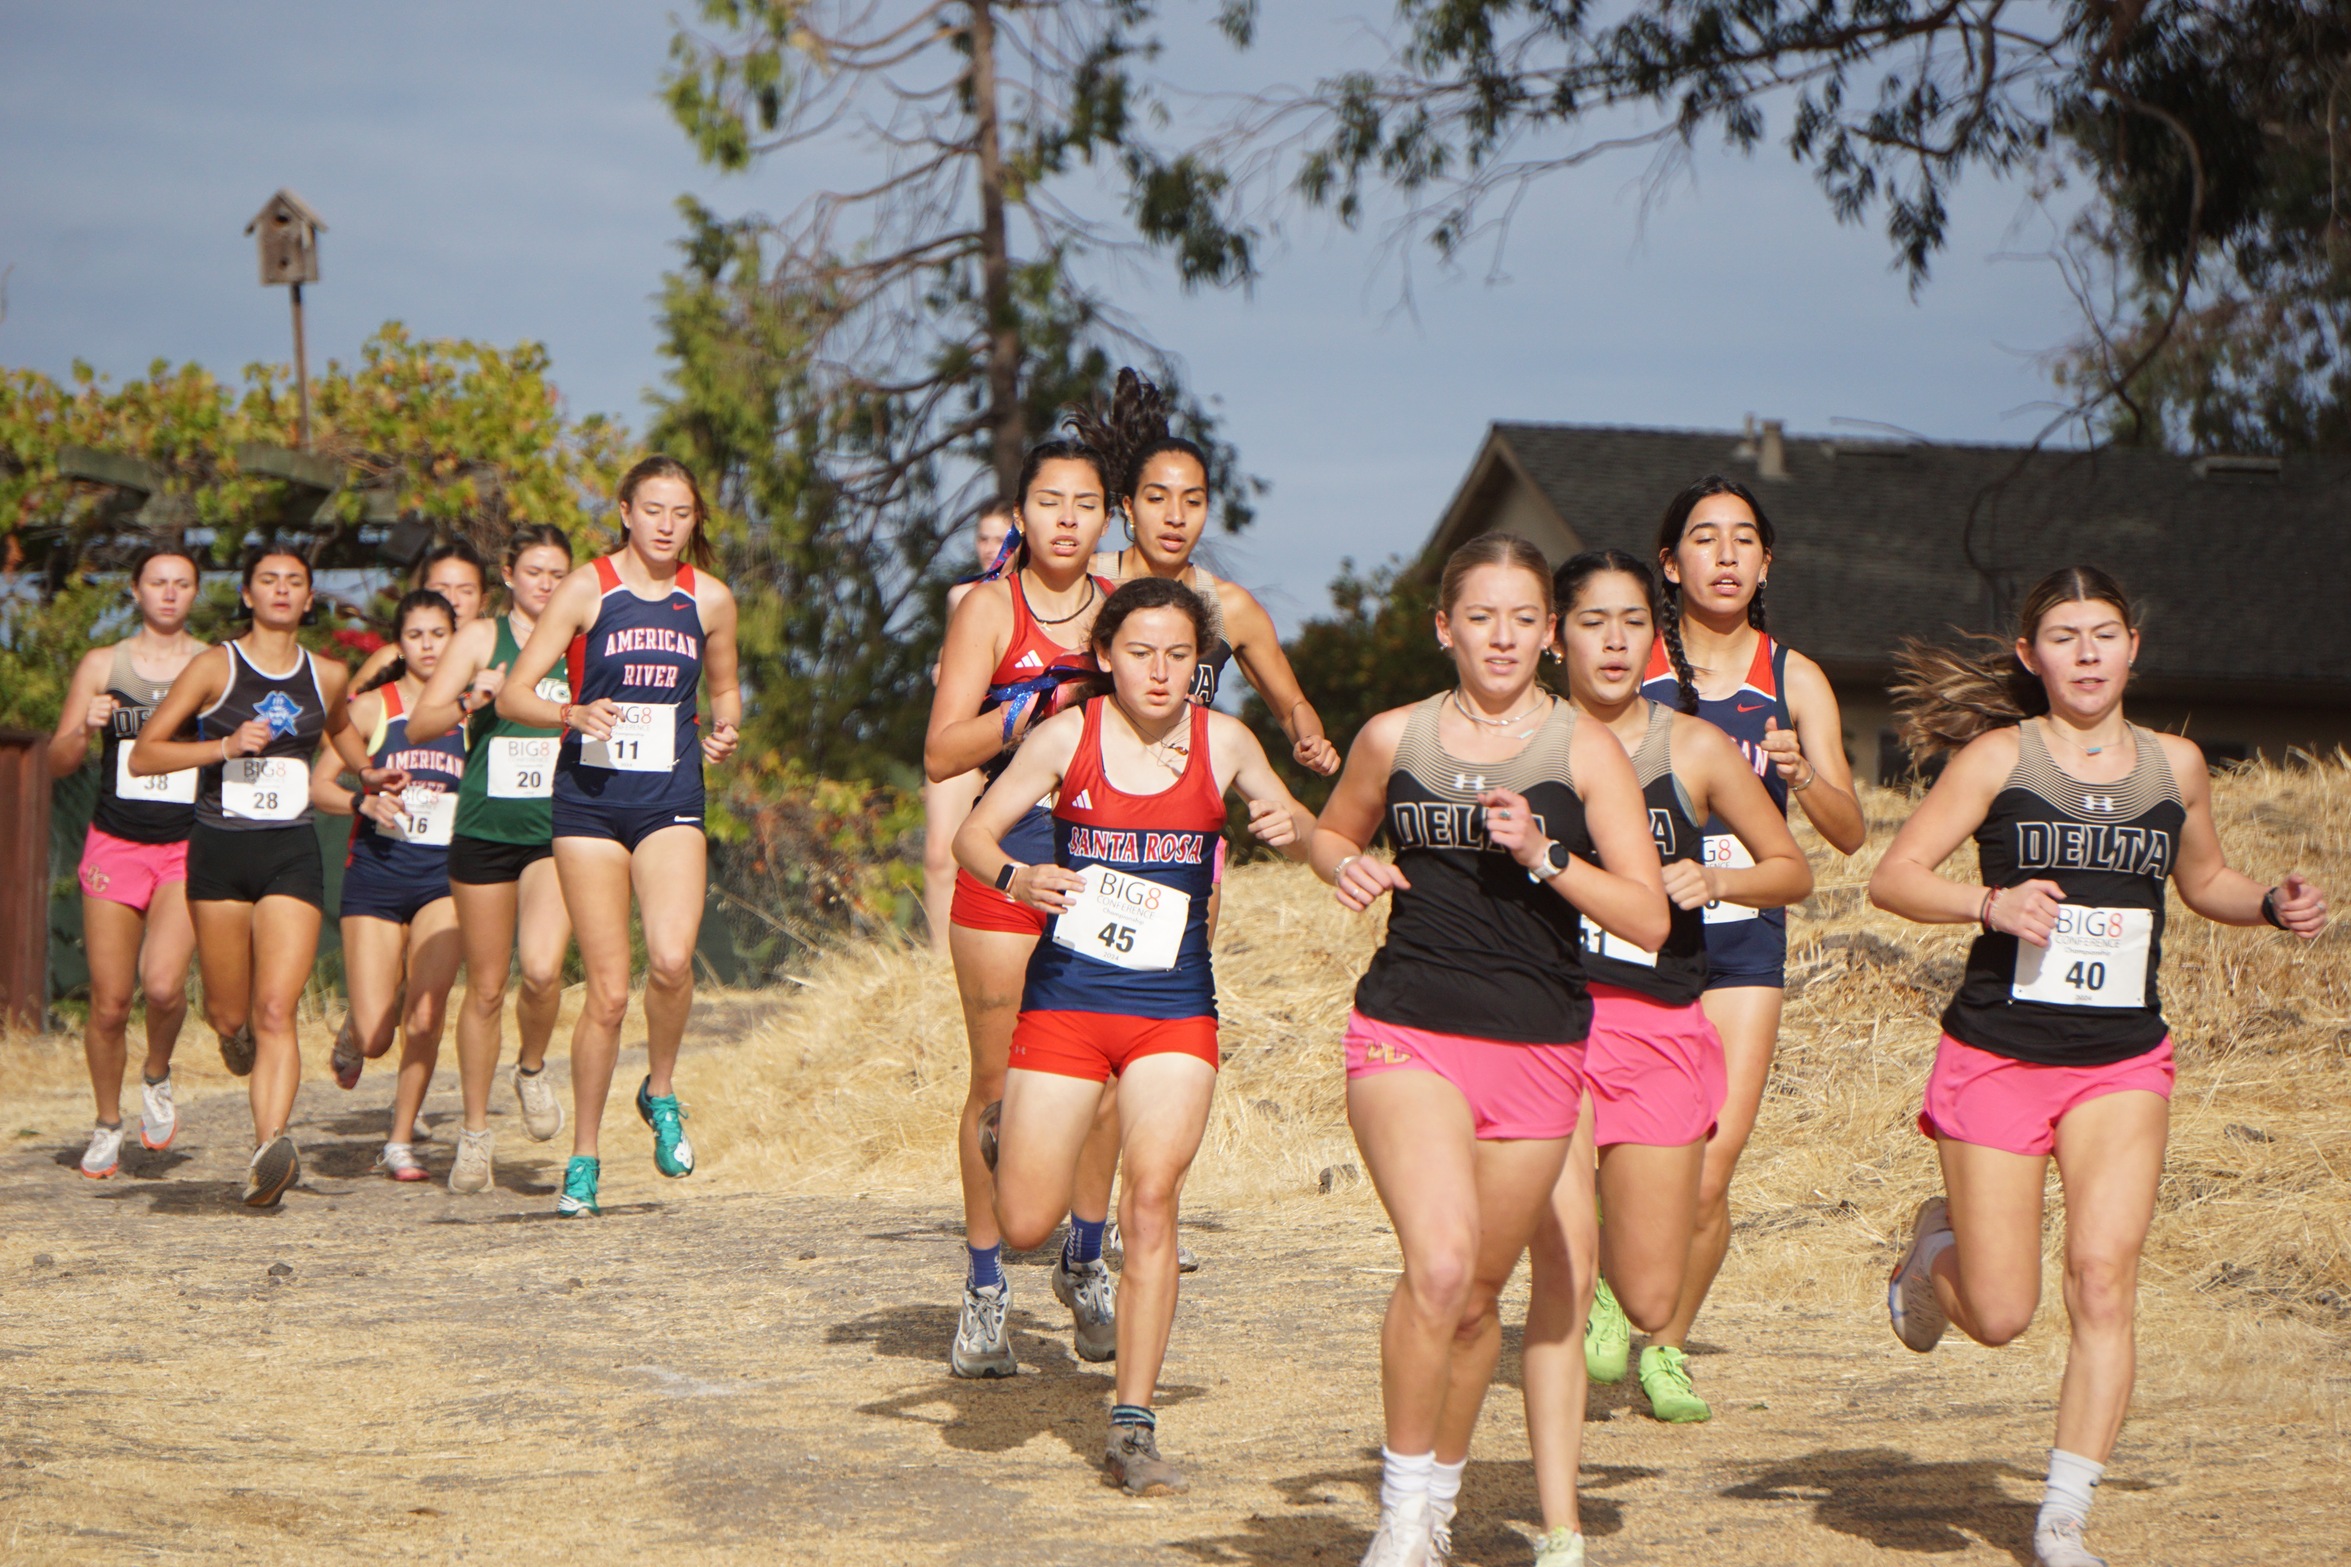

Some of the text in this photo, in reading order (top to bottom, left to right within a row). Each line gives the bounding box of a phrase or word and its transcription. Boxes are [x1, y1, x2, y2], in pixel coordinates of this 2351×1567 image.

[604, 627, 698, 660] AMERICAN
[622, 664, 679, 688] RIVER
[508, 740, 551, 757] BIG8
[614, 739, 638, 760] 11
[244, 760, 286, 777] BIG8
[385, 749, 465, 780] AMERICAN
[517, 771, 542, 788] 20
[253, 791, 278, 810] 28
[407, 815, 428, 834] 16
[1068, 826, 1203, 864] SANTA ROSA
[2016, 821, 2170, 880] DELTA
[1100, 872, 1161, 910] BIG8
[1096, 894, 1155, 920] CONFERENCE
[2056, 907, 2123, 938] BIG8
[1097, 921, 1137, 953] 45
[2065, 960, 2105, 990] 40
